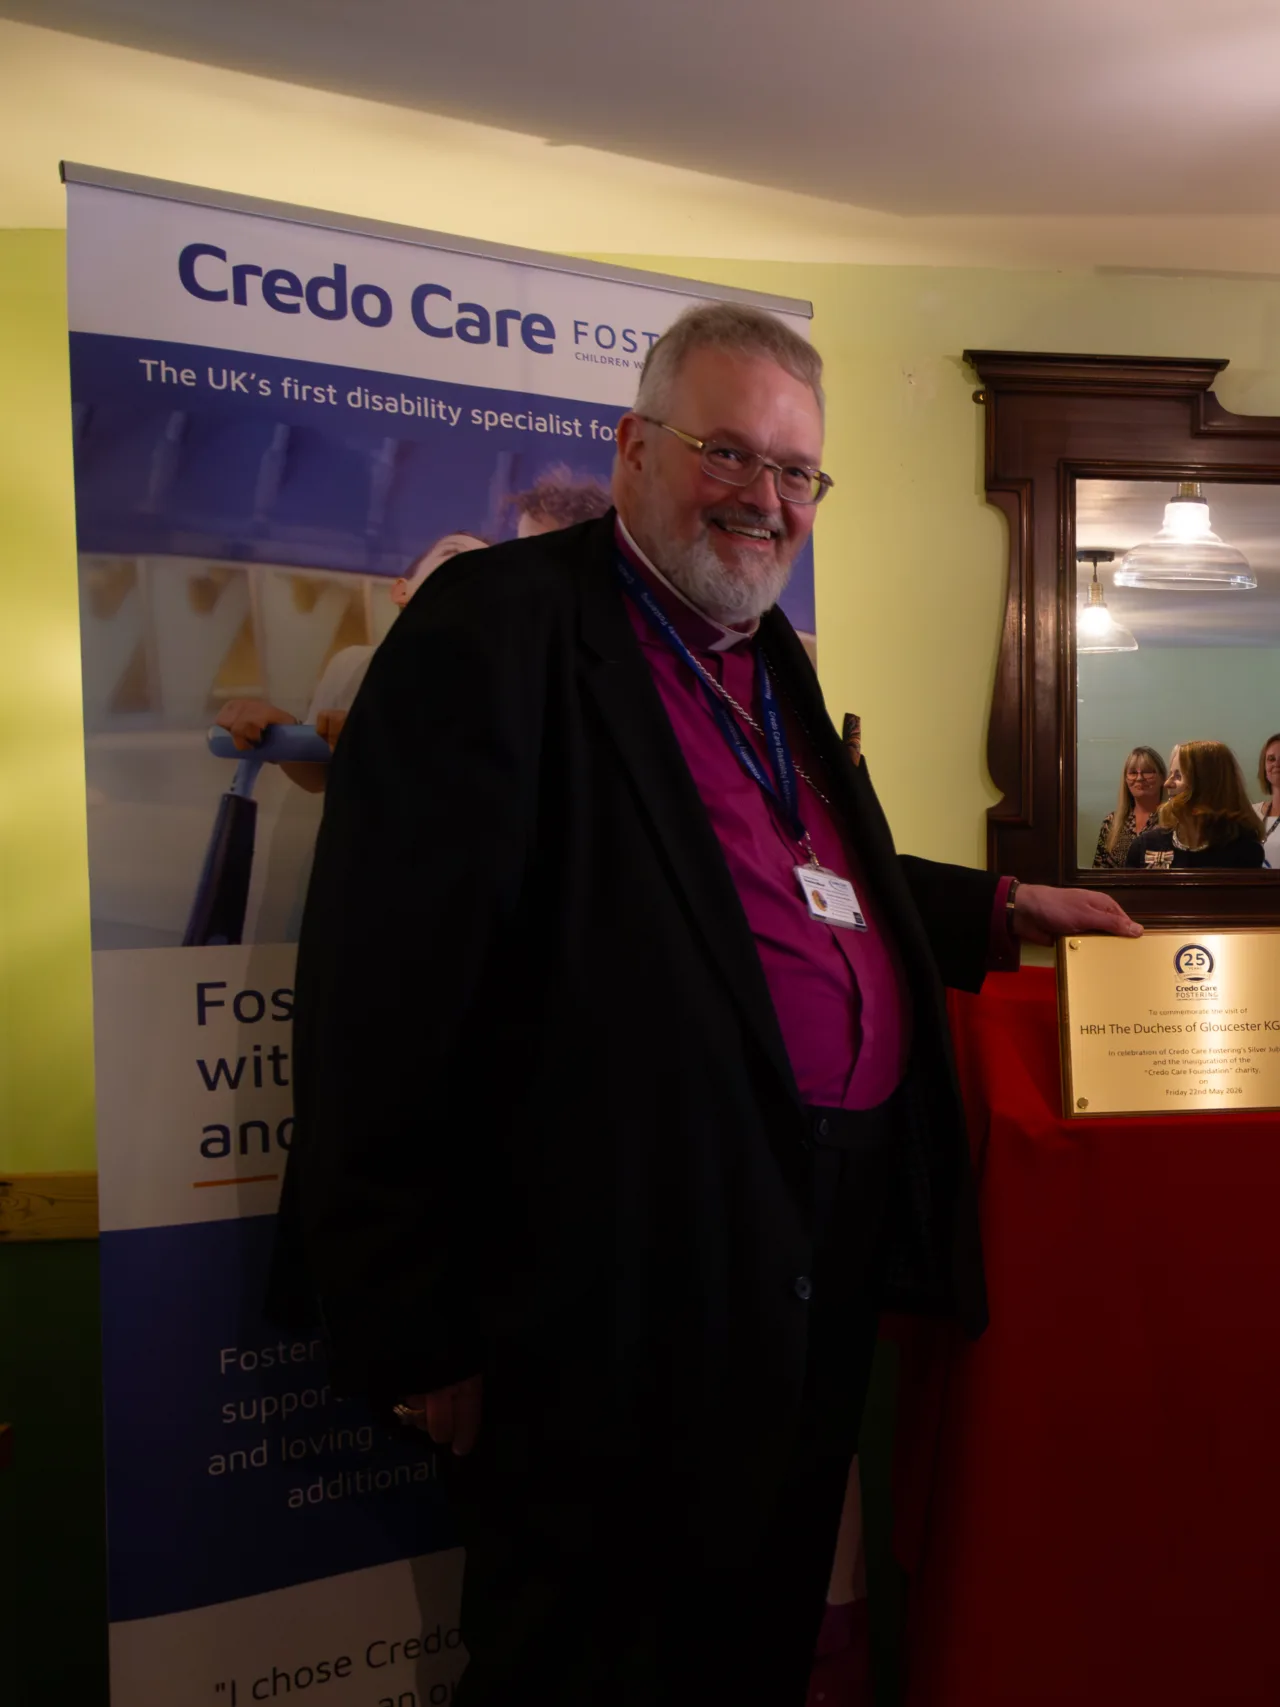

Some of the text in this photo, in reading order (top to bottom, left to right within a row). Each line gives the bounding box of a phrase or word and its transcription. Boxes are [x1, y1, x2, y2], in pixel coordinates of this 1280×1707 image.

[178, 242, 660, 355] Credo Care FOST
[574, 352, 630, 368] CHILDREN
[138, 358, 197, 387] The
[207, 367, 272, 397] UK's
[281, 376, 338, 406] first
[346, 386, 463, 427] disability
[470, 408, 583, 438] specialist
[1183, 952, 1206, 967] 25
[196, 981, 295, 1026] Fos
[1200, 984, 1218, 992] Care
[1080, 1024, 1106, 1035] HRH
[1108, 1023, 1131, 1034] The
[1133, 1022, 1183, 1034] Duchess
[1185, 1021, 1198, 1033] of
[1199, 1021, 1261, 1032] Gloucester
[1264, 1020, 1280, 1031] KG
[196, 1045, 289, 1092] wit
[1182, 1057, 1228, 1066] inauguration
[1208, 1046, 1246, 1055] Fostering's
[1171, 1068, 1187, 1076] Care
[1165, 1087, 1243, 1096] Friday 22nd May 2026
[219, 1339, 322, 1376] Foster
[221, 1383, 344, 1425] suppor
[207, 1425, 373, 1477] and loving
[287, 1450, 439, 1509] additional
[252, 1654, 352, 1701] chose
[366, 1622, 462, 1668] Credo
